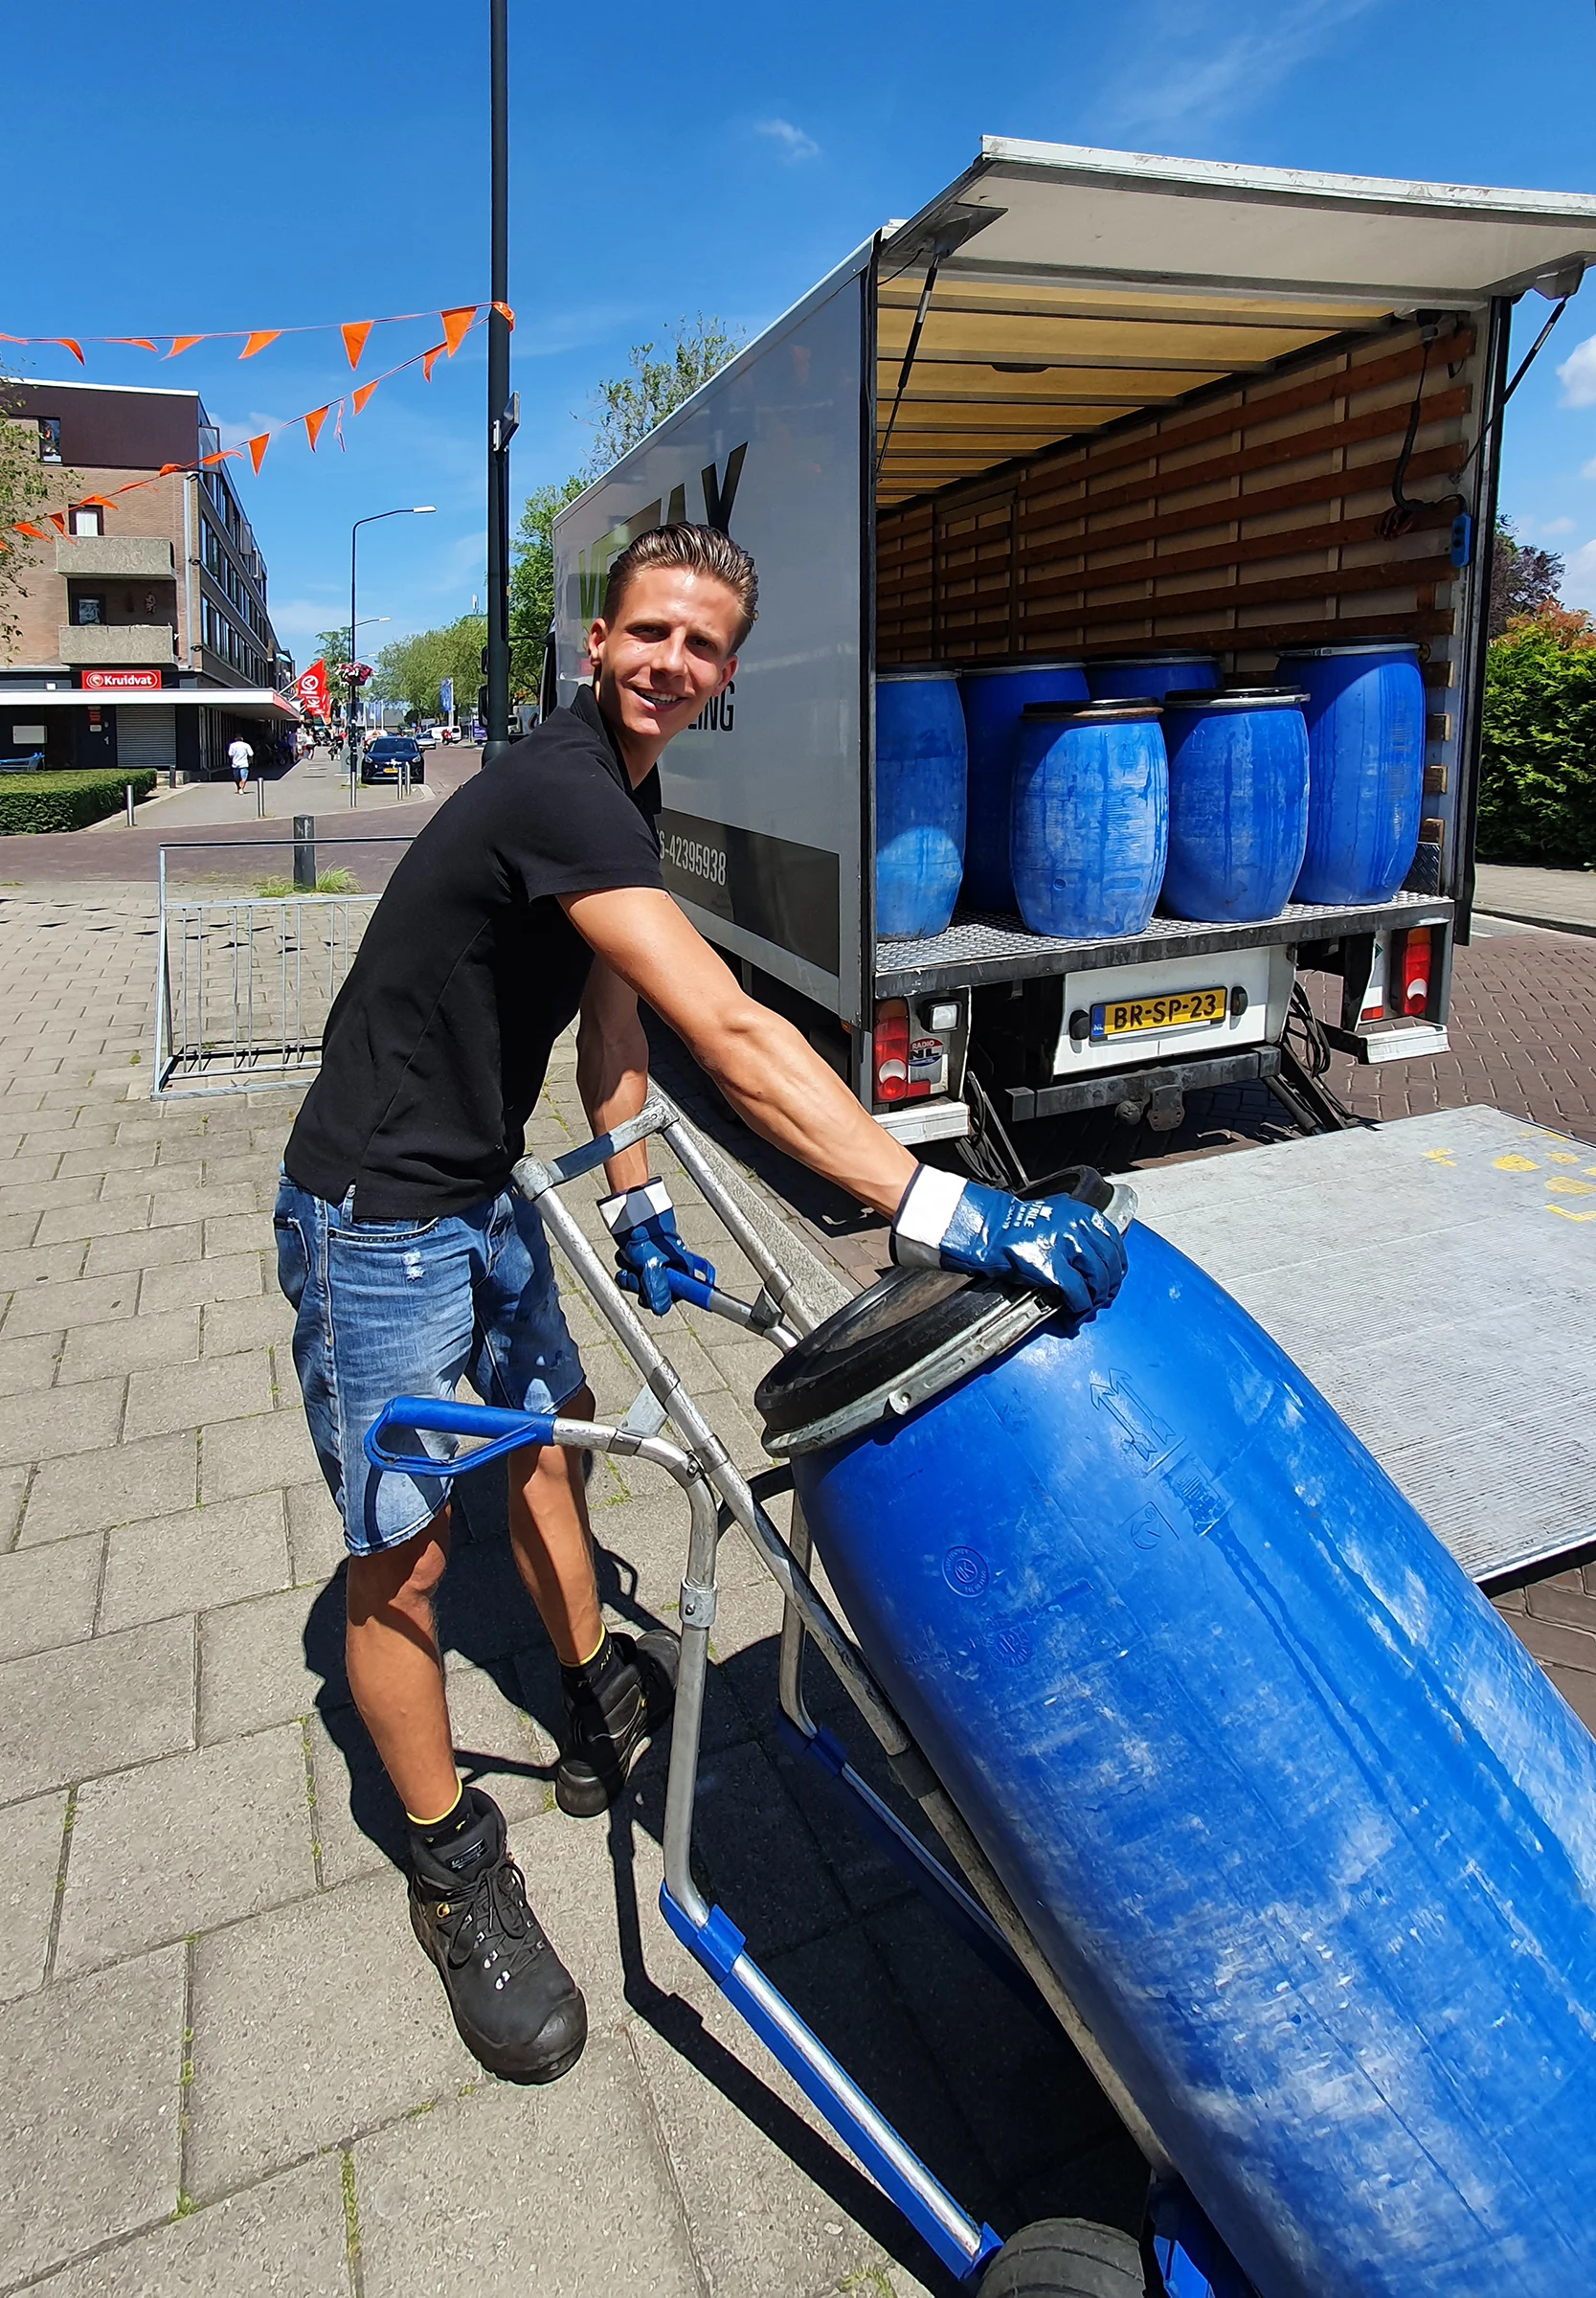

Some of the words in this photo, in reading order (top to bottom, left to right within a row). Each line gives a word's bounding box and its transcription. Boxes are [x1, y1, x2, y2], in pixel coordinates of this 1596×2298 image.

[104, 674, 152, 686] Kruidvat
[657, 829, 727, 886] 6-42395938
[1113, 993, 1217, 1031] BR-SP-23
[911, 1040, 935, 1050] RADIO
